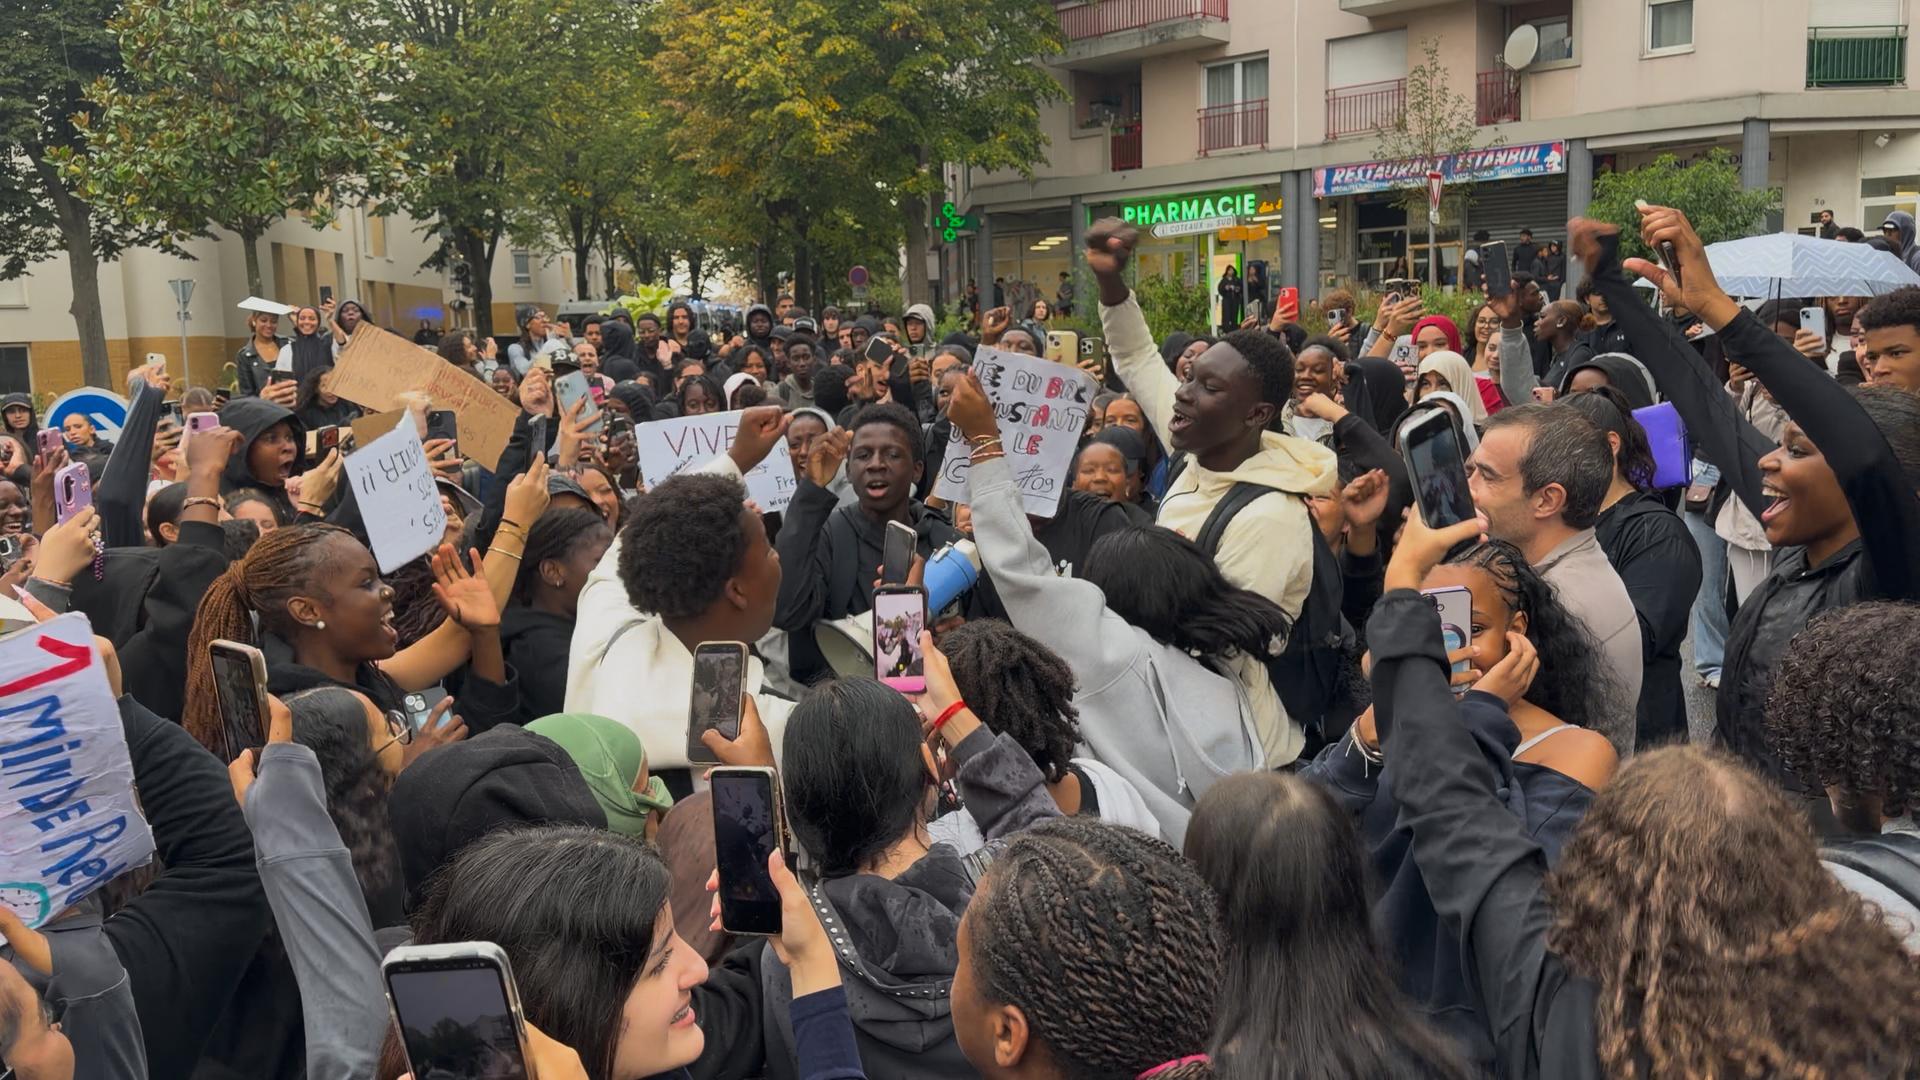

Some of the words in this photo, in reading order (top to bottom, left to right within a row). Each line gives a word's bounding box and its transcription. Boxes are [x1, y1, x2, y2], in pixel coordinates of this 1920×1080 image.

[1124, 193, 1256, 225] PHARMACIE
[1012, 369, 1042, 395] DU
[663, 425, 738, 457] VIVE
[1012, 432, 1043, 455] LE
